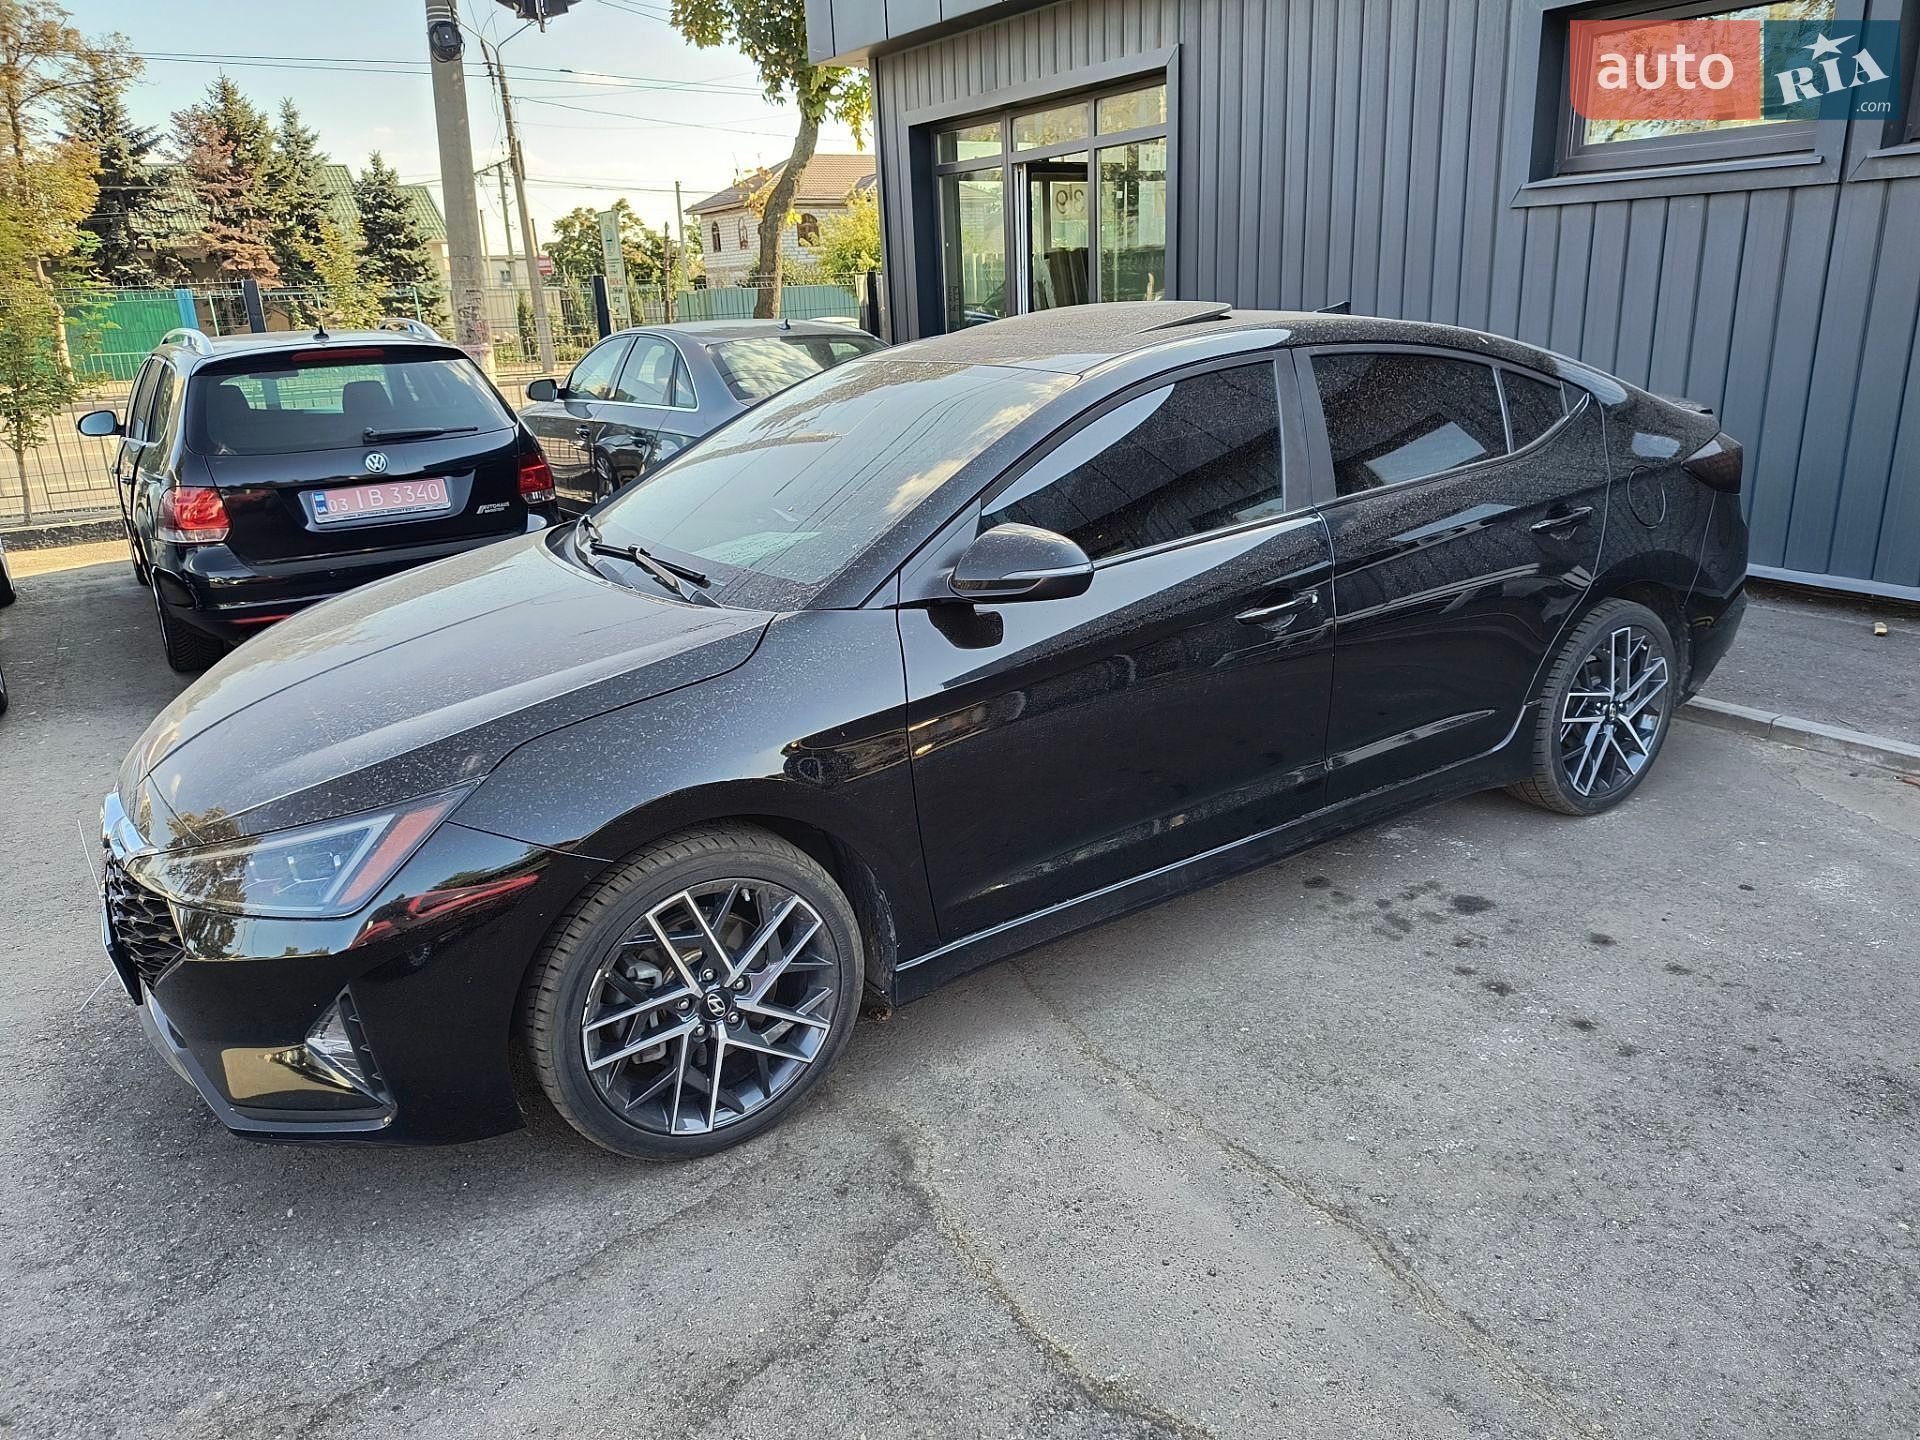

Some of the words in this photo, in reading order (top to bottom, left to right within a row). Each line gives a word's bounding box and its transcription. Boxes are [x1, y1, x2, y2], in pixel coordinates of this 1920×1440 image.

[329, 498, 349, 513] 03
[390, 483, 441, 505] 3340
[317, 505, 328, 513] UA
